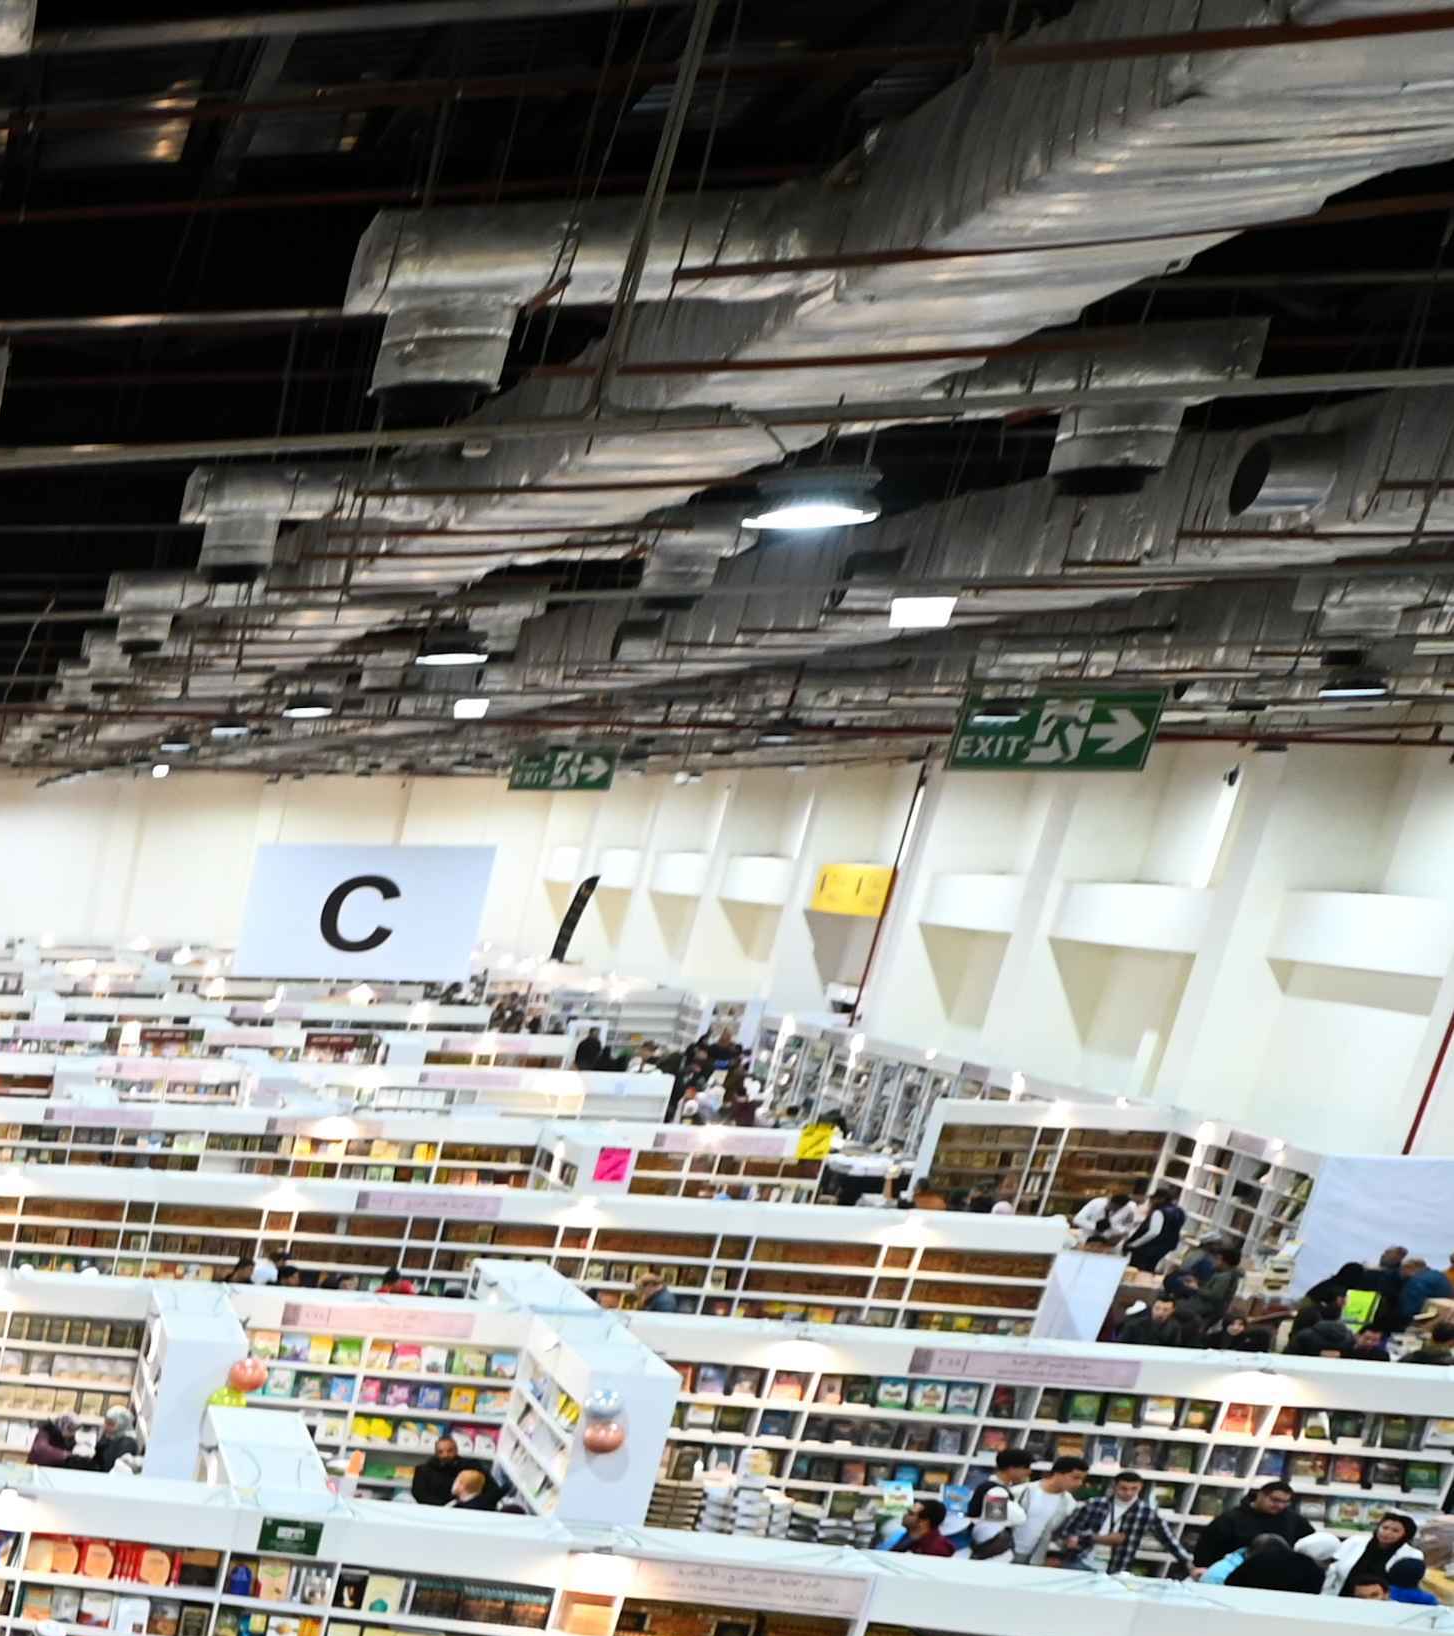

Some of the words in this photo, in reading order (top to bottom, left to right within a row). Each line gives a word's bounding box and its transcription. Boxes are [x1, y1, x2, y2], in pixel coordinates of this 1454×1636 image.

[955, 735, 1025, 758] EXIT
[513, 770, 548, 785] EXIT
[319, 874, 403, 953] C
